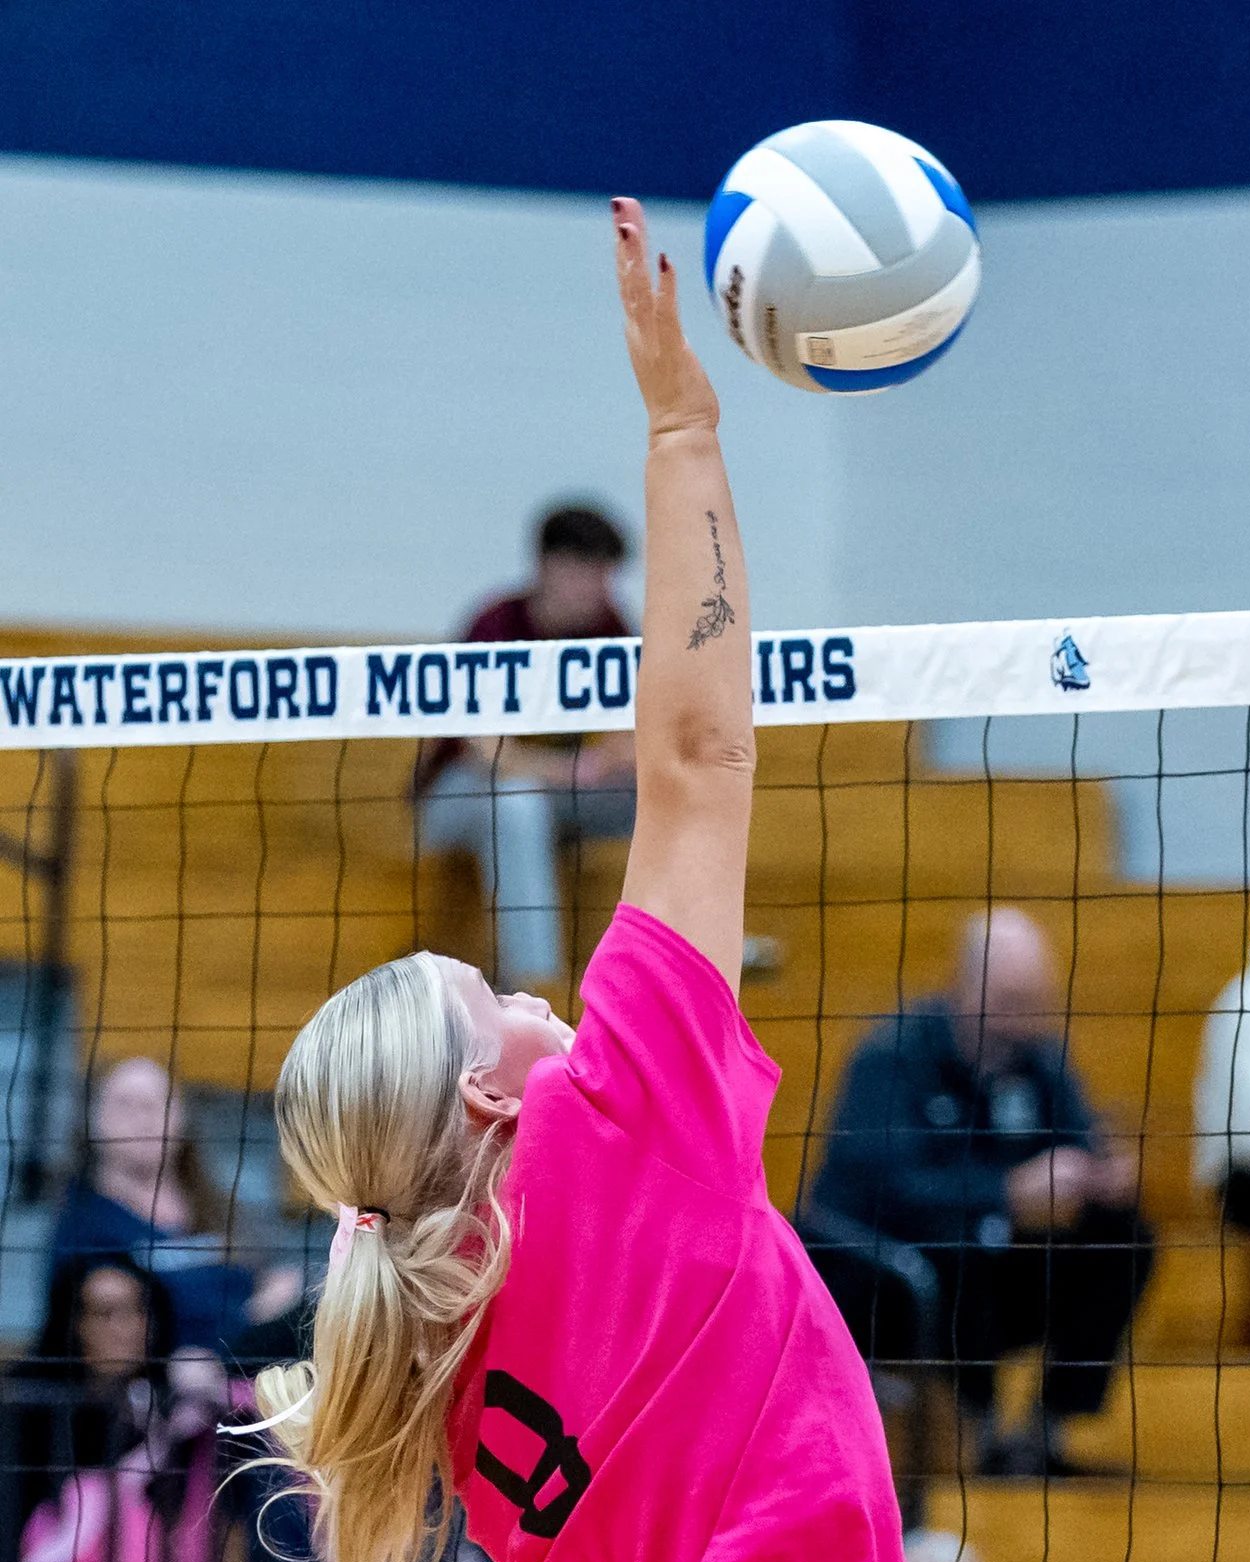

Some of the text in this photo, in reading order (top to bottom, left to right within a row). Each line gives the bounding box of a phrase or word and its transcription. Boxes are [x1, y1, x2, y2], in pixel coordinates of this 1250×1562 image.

[0, 637, 857, 726] WATERFORD MOTT COIRS
